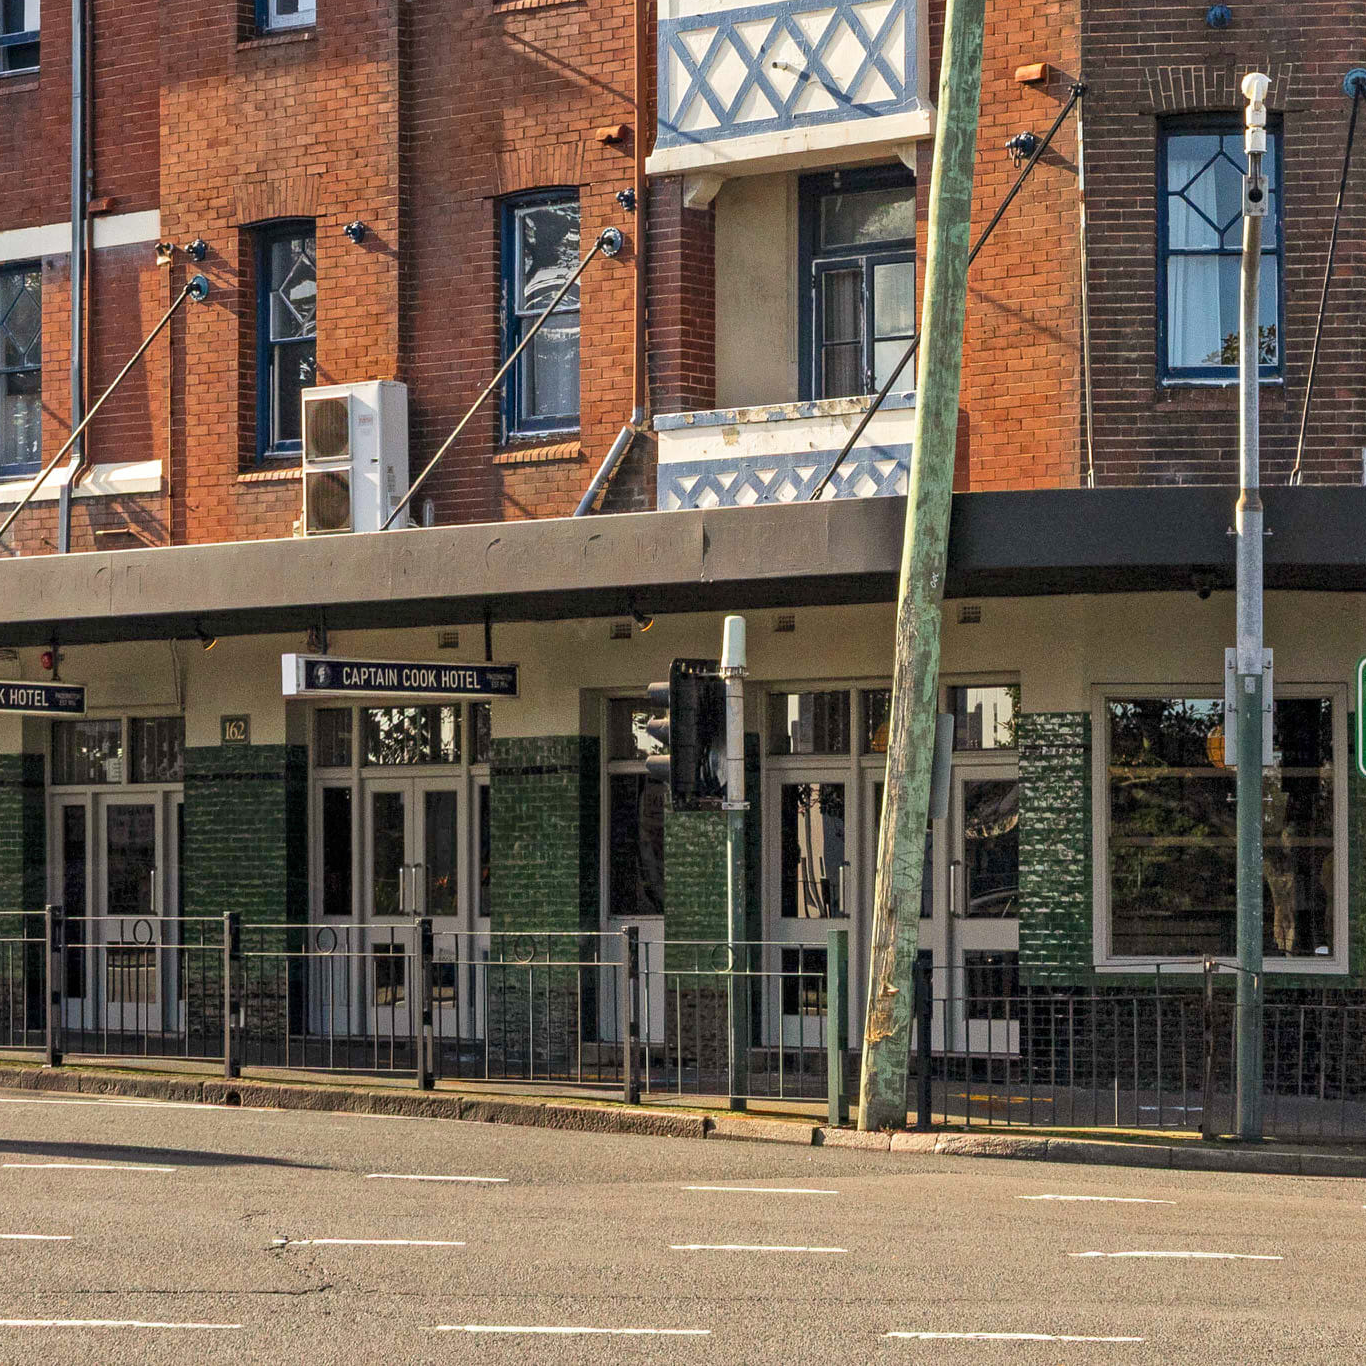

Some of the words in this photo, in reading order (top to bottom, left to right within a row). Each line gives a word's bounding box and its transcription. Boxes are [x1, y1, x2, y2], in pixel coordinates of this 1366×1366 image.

[342, 666, 398, 687] CAPTAIN
[402, 668, 438, 688] COOK
[441, 670, 481, 690] HOTEL
[9, 689, 49, 707] HOTEL
[224, 721, 246, 740] 162
